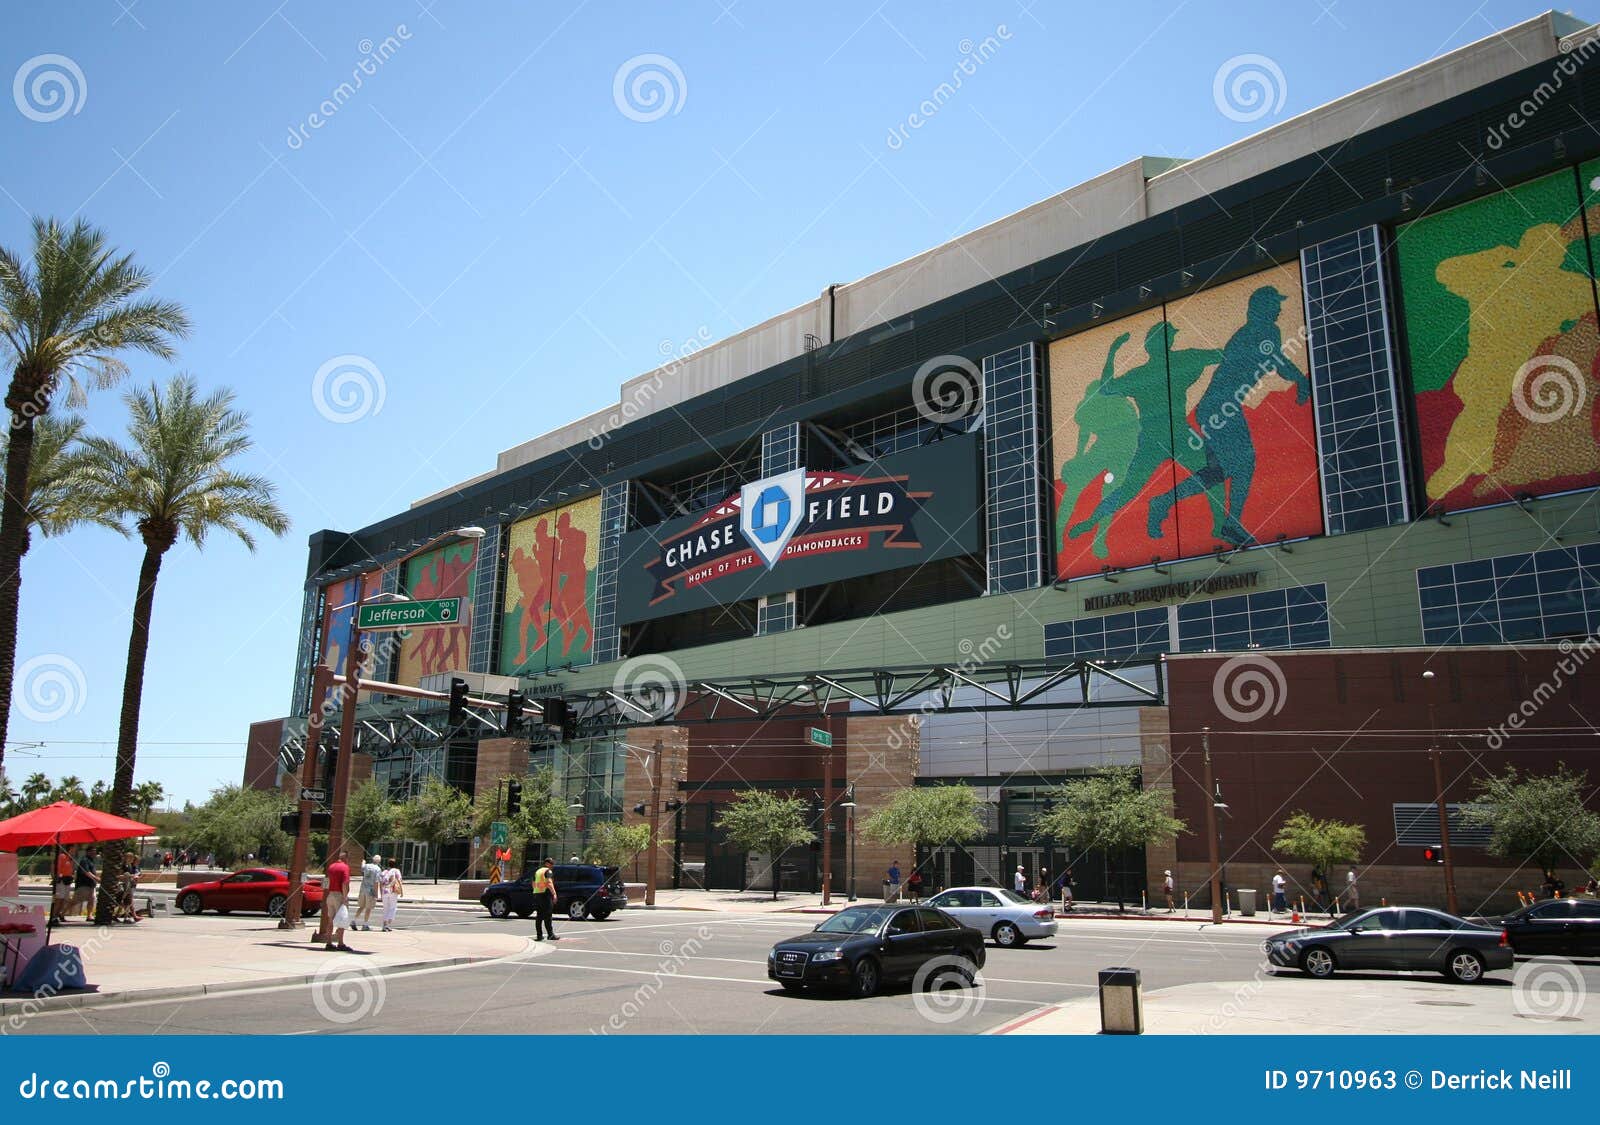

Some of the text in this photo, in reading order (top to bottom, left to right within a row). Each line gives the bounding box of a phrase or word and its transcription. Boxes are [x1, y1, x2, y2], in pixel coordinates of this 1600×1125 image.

[665, 492, 895, 568] CHASE FIELD
[688, 535, 863, 583] HOME OF THE DIAMONDBACKS
[367, 607, 425, 622] Jefferson
